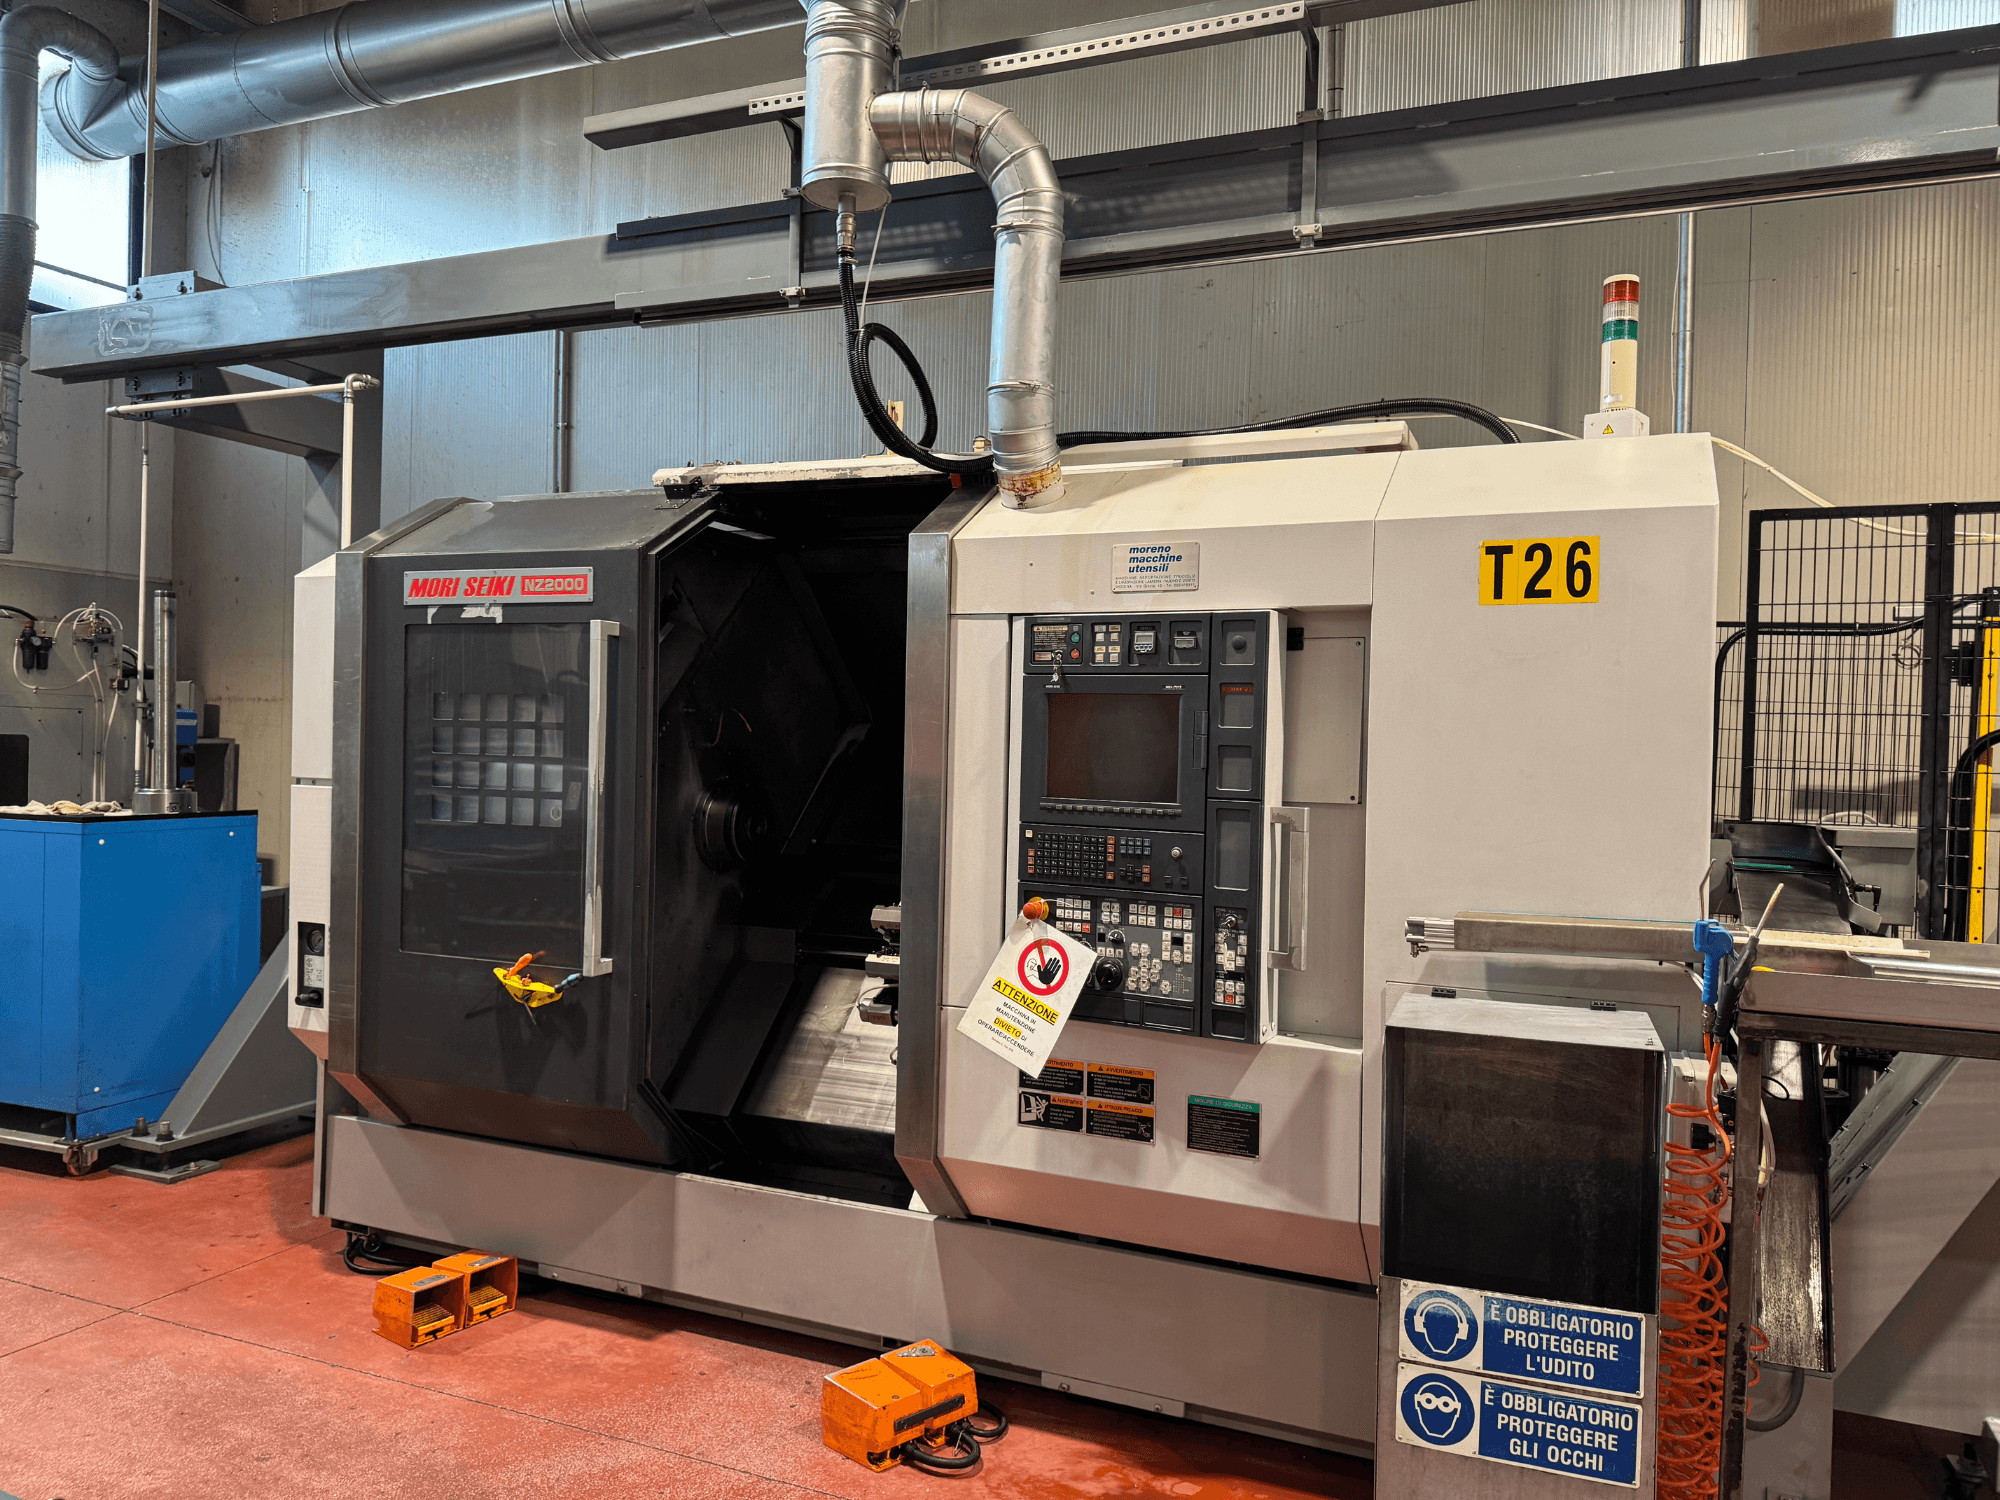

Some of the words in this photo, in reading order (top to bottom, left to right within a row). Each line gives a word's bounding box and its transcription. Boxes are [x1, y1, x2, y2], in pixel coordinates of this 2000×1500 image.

[1129, 546, 1171, 554] moreno
[1129, 554, 1183, 563] macchine
[1128, 563, 1170, 573] utensili
[1485, 541, 1592, 600] T26
[408, 578, 461, 598] MORI
[463, 576, 516, 597] SEIKI
[524, 577, 585, 592] NZ2000
[992, 979, 1059, 1023] ATTENZIONE
[1003, 1001, 1030, 1021] MACCHINA
[993, 1017, 1022, 1038] DIVIETO
[996, 1007, 1036, 1034] MANUTENZIONE
[977, 1019, 1035, 1057] OPERARE/ACCENDERE
[1106, 1067, 1144, 1076] AVVERTIMENTO
[1490, 1300, 1501, 1322] È
[1505, 1306, 1634, 1341] OBBLIGATORIO
[1503, 1328, 1619, 1361] PROTEGGERE
[1526, 1353, 1595, 1381] L'UDITO
[1484, 1385, 1495, 1405] È
[1501, 1392, 1634, 1431] OBBLIGATORIO
[1497, 1414, 1619, 1452] PROTEGGERE
[1509, 1438, 1538, 1459] GLI
[1547, 1445, 1604, 1472] OCCHI
